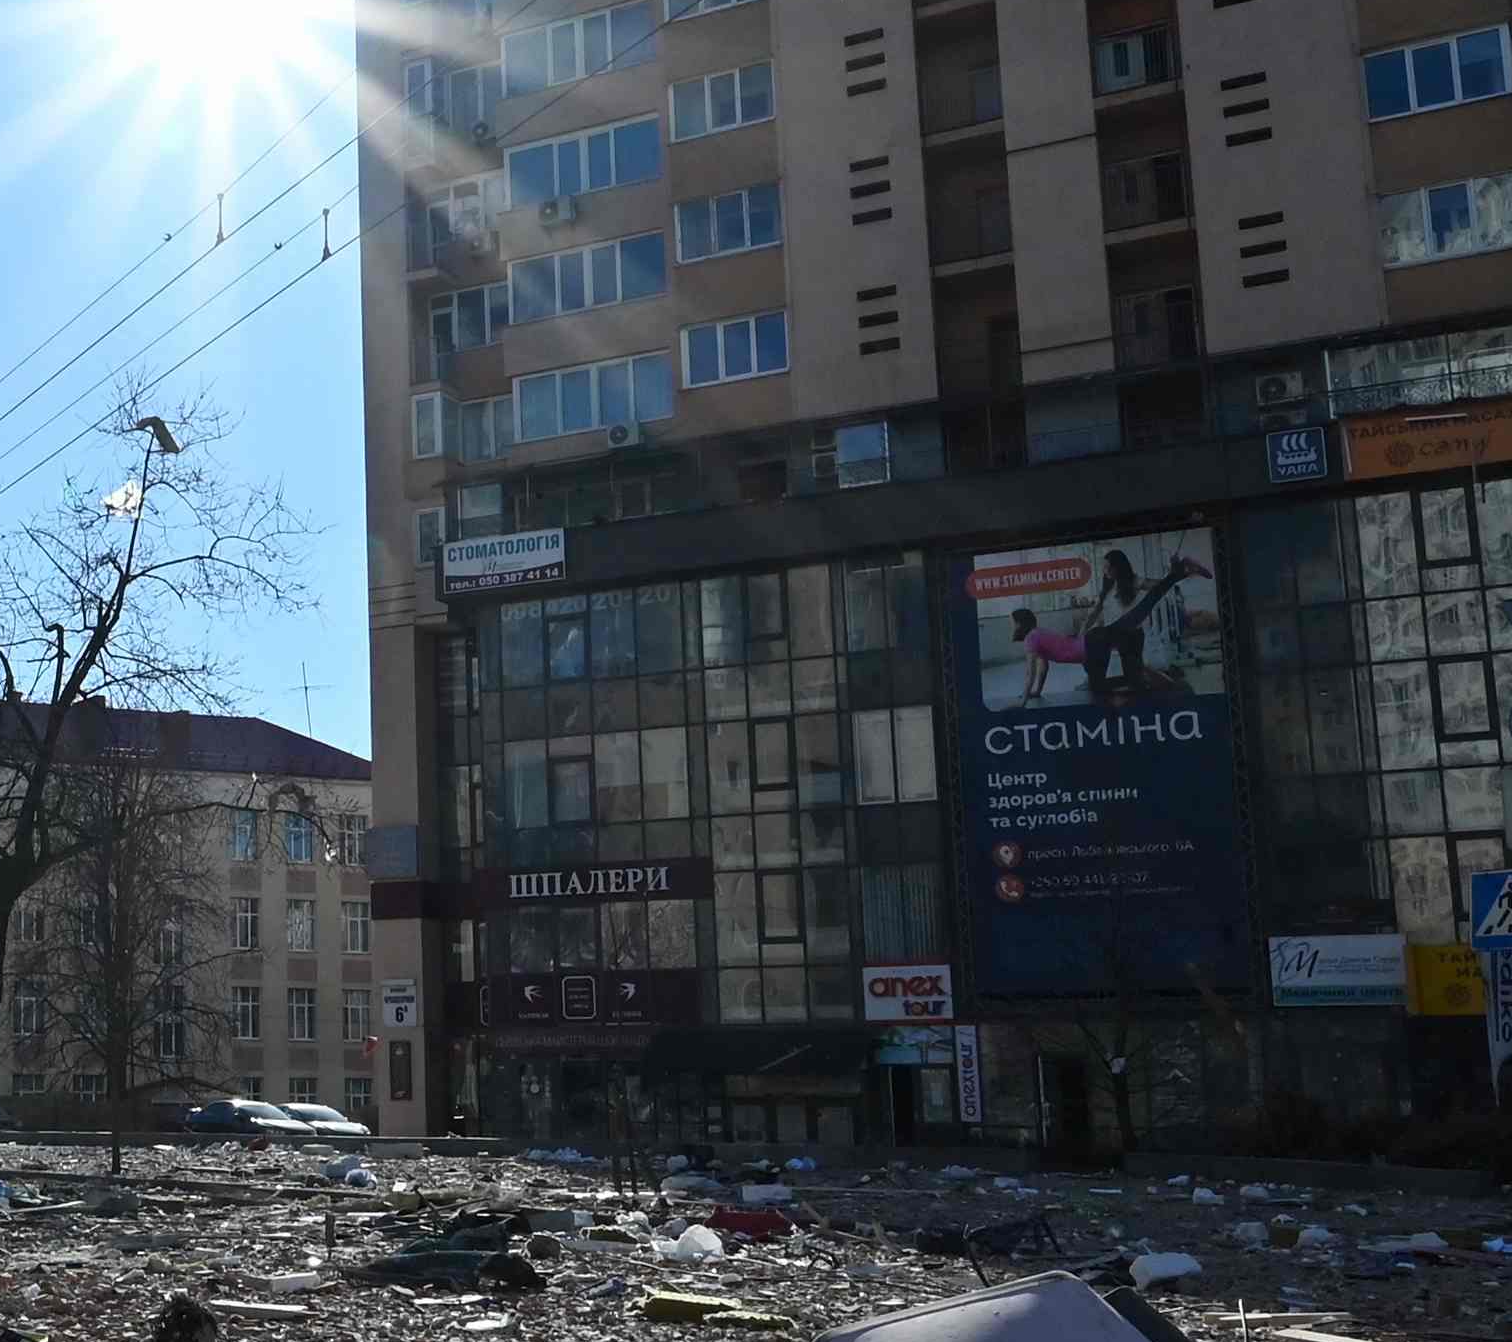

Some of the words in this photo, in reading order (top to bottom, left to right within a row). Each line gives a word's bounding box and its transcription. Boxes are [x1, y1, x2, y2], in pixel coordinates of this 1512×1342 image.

[1278, 463, 1319, 476] YARA
[448, 533, 560, 563] СТОМАТОЛОГІЯ
[479, 575, 501, 587] 050
[503, 572, 524, 584] 387
[527, 570, 541, 580] 41
[545, 567, 559, 578] 14
[988, 772, 1048, 789] Центр
[988, 789, 1072, 811] здоров'я
[989, 815, 1012, 828] та
[509, 866, 672, 899] ШПАЛЕРИ
[869, 975, 945, 997] anex
[903, 999, 946, 1017] tour
